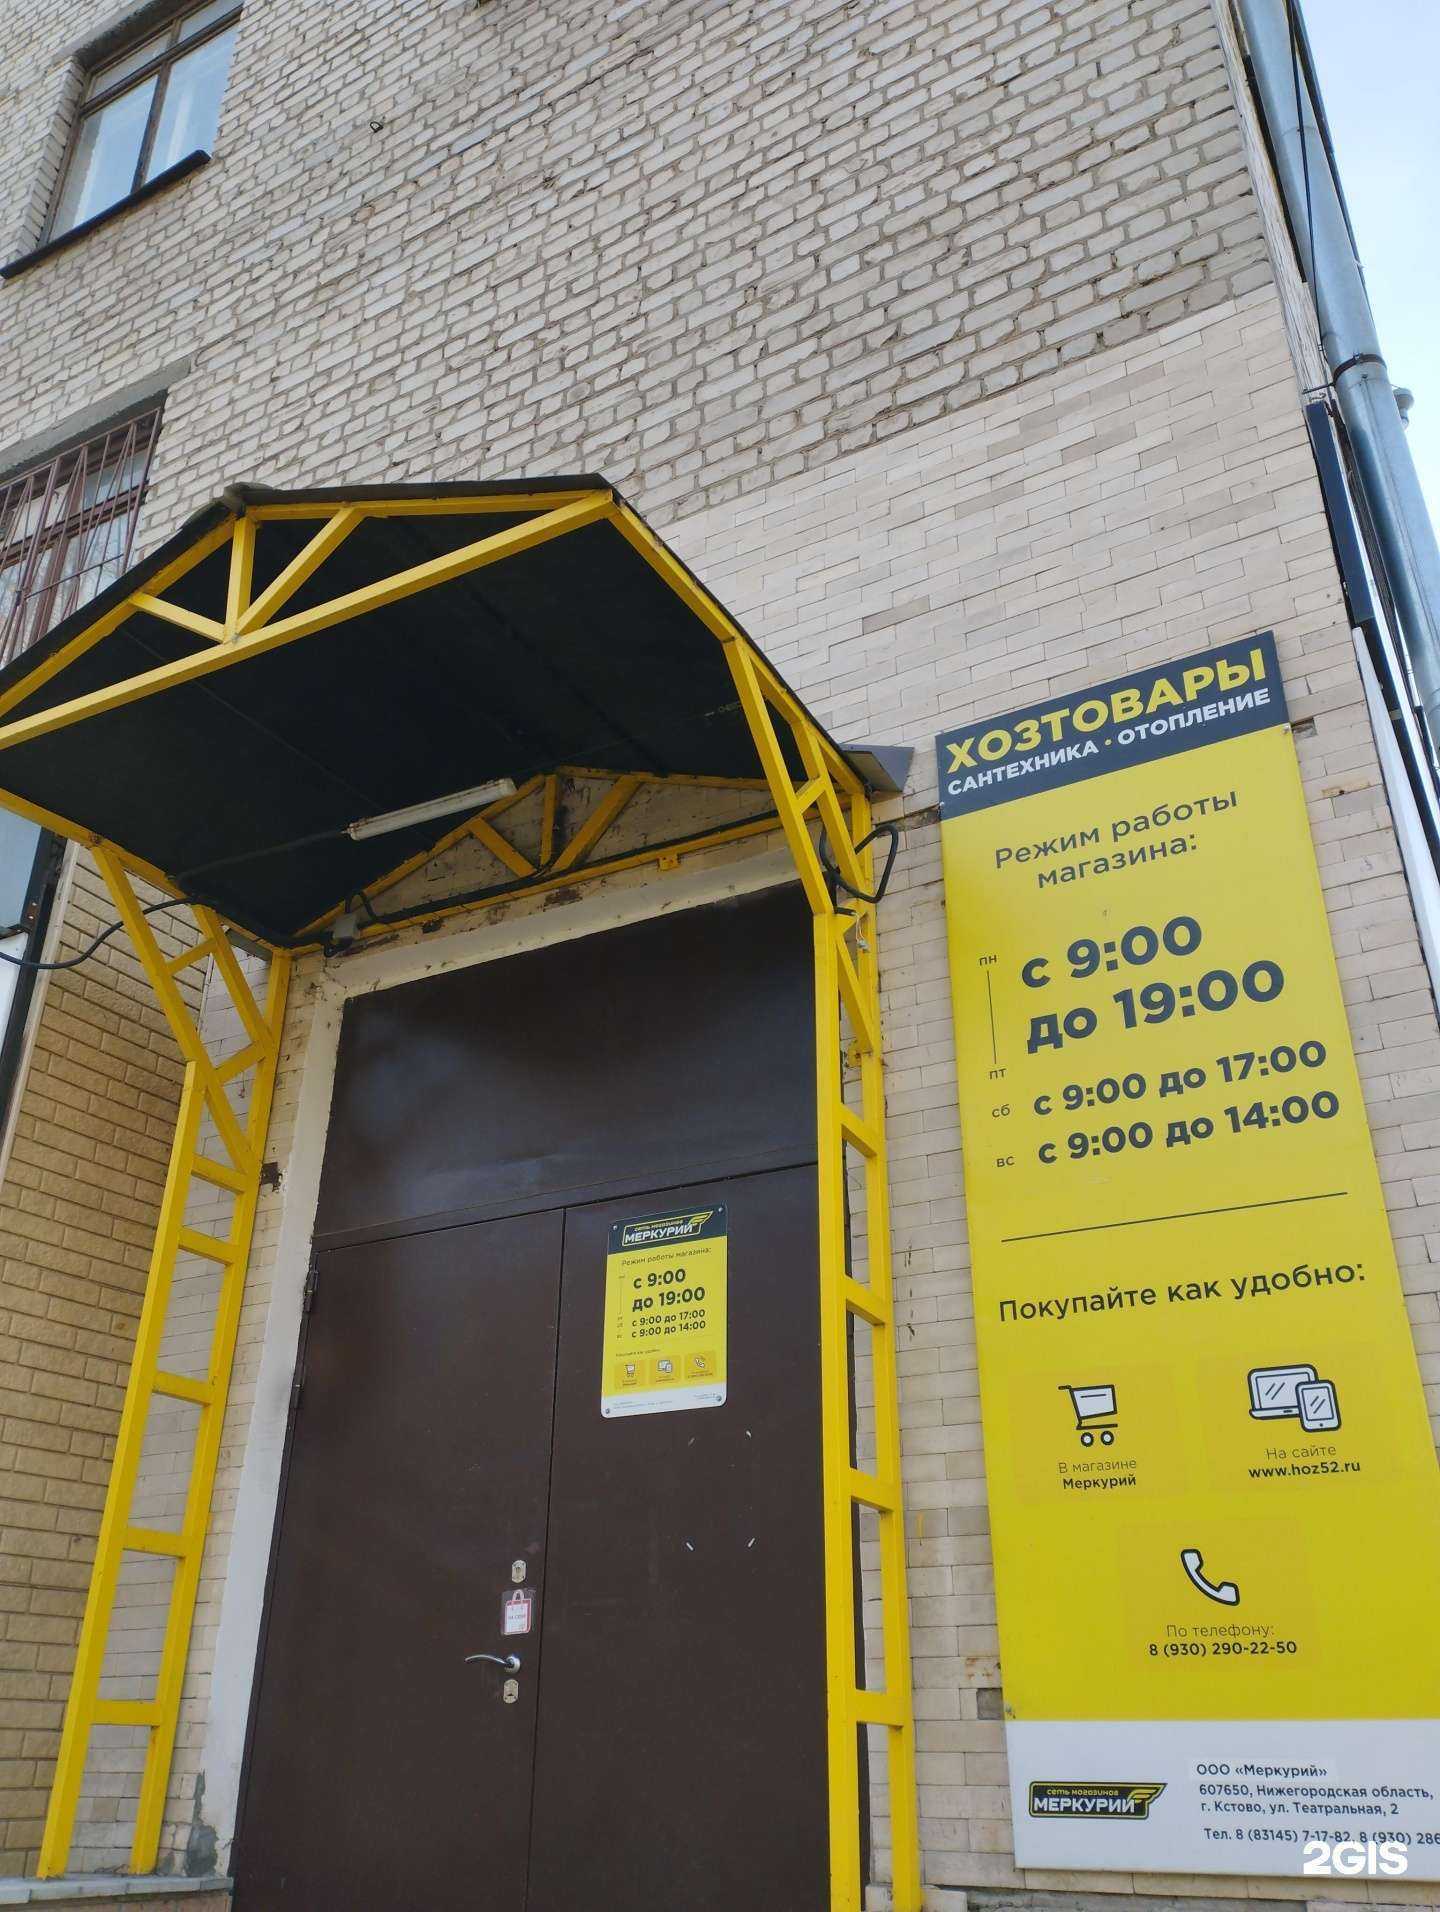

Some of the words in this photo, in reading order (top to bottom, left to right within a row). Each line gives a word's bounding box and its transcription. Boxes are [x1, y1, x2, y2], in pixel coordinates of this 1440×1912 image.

[945, 648, 1266, 774] ХОЗТОВАРЫ
[947, 740, 1098, 796] САНТЕХНИКА
[1117, 688, 1271, 746] ОТОПЛЕНИЕ
[995, 828, 1100, 869] Режим
[1112, 791, 1238, 841] работы
[1038, 833, 1198, 889] магазина:
[979, 954, 997, 966] пн
[1021, 957, 1051, 988] с
[1067, 916, 1202, 979] 9:00
[1027, 1007, 1097, 1054] до
[1113, 960, 1284, 1029] 19:00
[989, 1067, 1007, 1080] пт
[1033, 1095, 1053, 1116] с
[1062, 1073, 1147, 1111] 9:00
[1159, 1067, 1207, 1098] до
[1216, 1040, 1327, 1082] 17:00
[991, 1104, 1010, 1118] сб
[1038, 1142, 1058, 1164] с
[1067, 1121, 1154, 1159] 9:00
[1166, 1116, 1214, 1148] до
[1224, 1090, 1340, 1133] 14:00
[996, 1156, 1015, 1168] вс
[647, 1254, 673, 1263] работы
[634, 1278, 642, 1289] с
[647, 1268, 686, 1287] 9:00
[632, 1297, 653, 1312] до
[659, 1287, 705, 1306] 19:00
[999, 1287, 1157, 1322] Покупайте
[1168, 1280, 1220, 1303] как
[1231, 1262, 1366, 1300] удобно:
[640, 1315, 662, 1325] 9:00
[664, 1315, 676, 1323] до
[679, 1309, 705, 1320] 17:00
[640, 1327, 661, 1337] 9:00
[664, 1326, 676, 1334] до
[679, 1320, 706, 1331] 14:00
[1266, 1448, 1287, 1460] На
[1292, 1444, 1337, 1459] сайте
[1058, 1462, 1068, 1474] В
[1072, 1458, 1137, 1473] магазине
[1249, 1460, 1361, 1479] www.hoz52.ru
[1063, 1474, 1136, 1490] Меркурий
[1167, 1625, 1188, 1637] По
[1192, 1623, 1275, 1638] телефону:
[1149, 1644, 1158, 1656] 8
[1164, 1643, 1206, 1657] (930)
[1212, 1641, 1297, 1655] 290-22-50
[1197, 1764, 1230, 1775] ООО
[1235, 1764, 1327, 1778] «Меркурий»
[1200, 1784, 1253, 1798] 607650,
[1257, 1785, 1367, 1799] Нижегородская
[1372, 1786, 1434, 1799] область,
[1201, 1803, 1211, 1812] г.
[1215, 1801, 1265, 1814] Кстово,
[1270, 1803, 1289, 1815] ул.
[1293, 1802, 1386, 1816] Театральная,
[1391, 1803, 1399, 1814] 2
[1204, 1828, 1232, 1840] Тел.
[1236, 1829, 1243, 1840] 8
[1248, 1828, 1298, 1842] (83145)
[1359, 1832, 1368, 1843] 8
[1372, 1832, 1411, 1845] (930)
